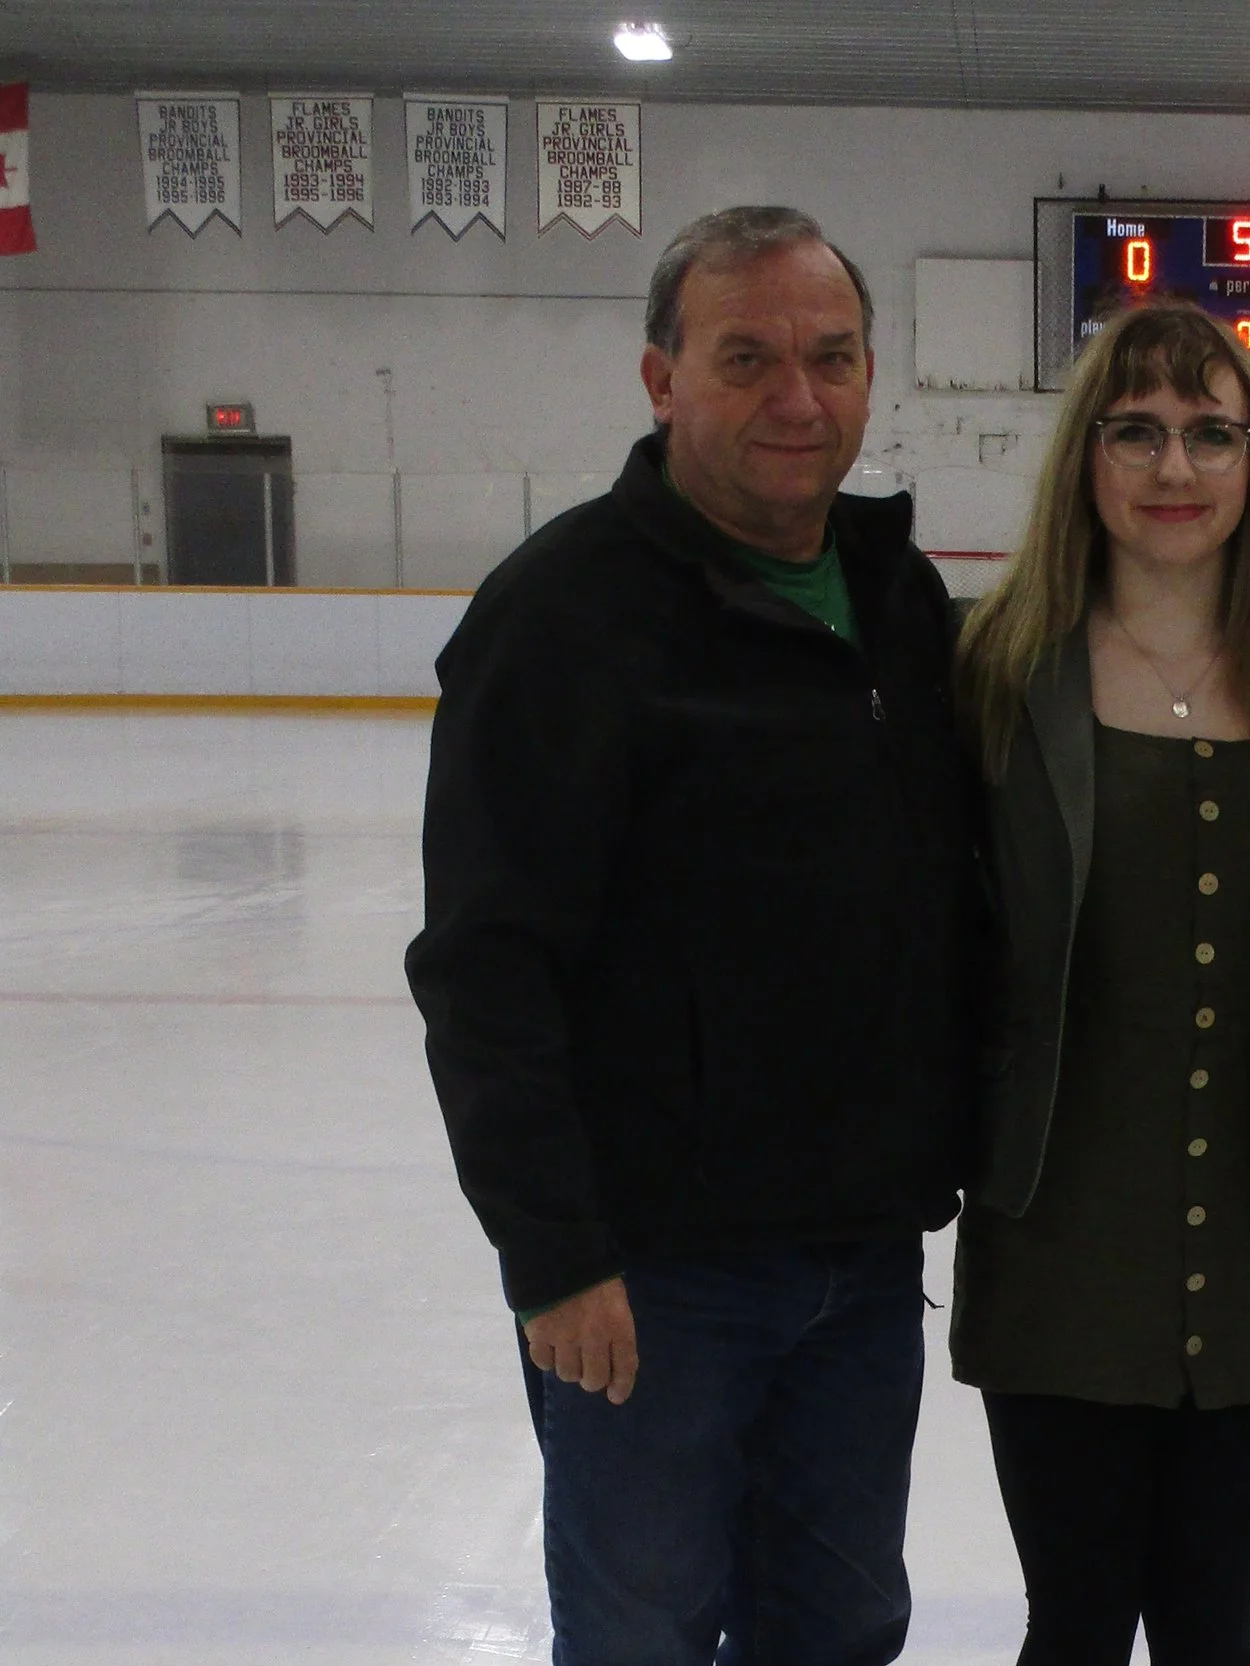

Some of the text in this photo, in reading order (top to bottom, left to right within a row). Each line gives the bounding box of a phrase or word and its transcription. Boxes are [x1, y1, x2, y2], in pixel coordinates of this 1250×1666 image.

[159, 106, 216, 119] BANDITS
[293, 102, 350, 115] FLAMES
[428, 108, 484, 123] BANDITS
[559, 108, 616, 122] FLAMES
[160, 120, 218, 133] JR BOYS
[314, 117, 358, 130] GIRLS
[427, 123, 485, 137] JR BOYS
[580, 123, 624, 136] GIRLS
[149, 133, 228, 147] PROVINCIAL
[277, 131, 366, 144] PROVINCIAL
[416, 136, 494, 152] PROVINCIAL
[543, 137, 633, 151] PROVINCIAL
[149, 148, 230, 161] BROOMBALL
[282, 145, 367, 159] BROOMBALL
[415, 150, 496, 165] BROOMBALL
[548, 151, 633, 166] BROOMBALL
[163, 162, 218, 175] CHAMPS
[295, 160, 352, 172] CHAMPS
[428, 165, 483, 179] CHAMPS
[560, 166, 617, 180] CHAMPS
[284, 174, 364, 187] 1993-1994
[422, 178, 490, 193] 1992-1993
[284, 188, 364, 201] 1995-1996
[422, 192, 490, 206] 1993-1994
[1107, 218, 1145, 237] Home
[1128, 242, 1149, 281] 0
